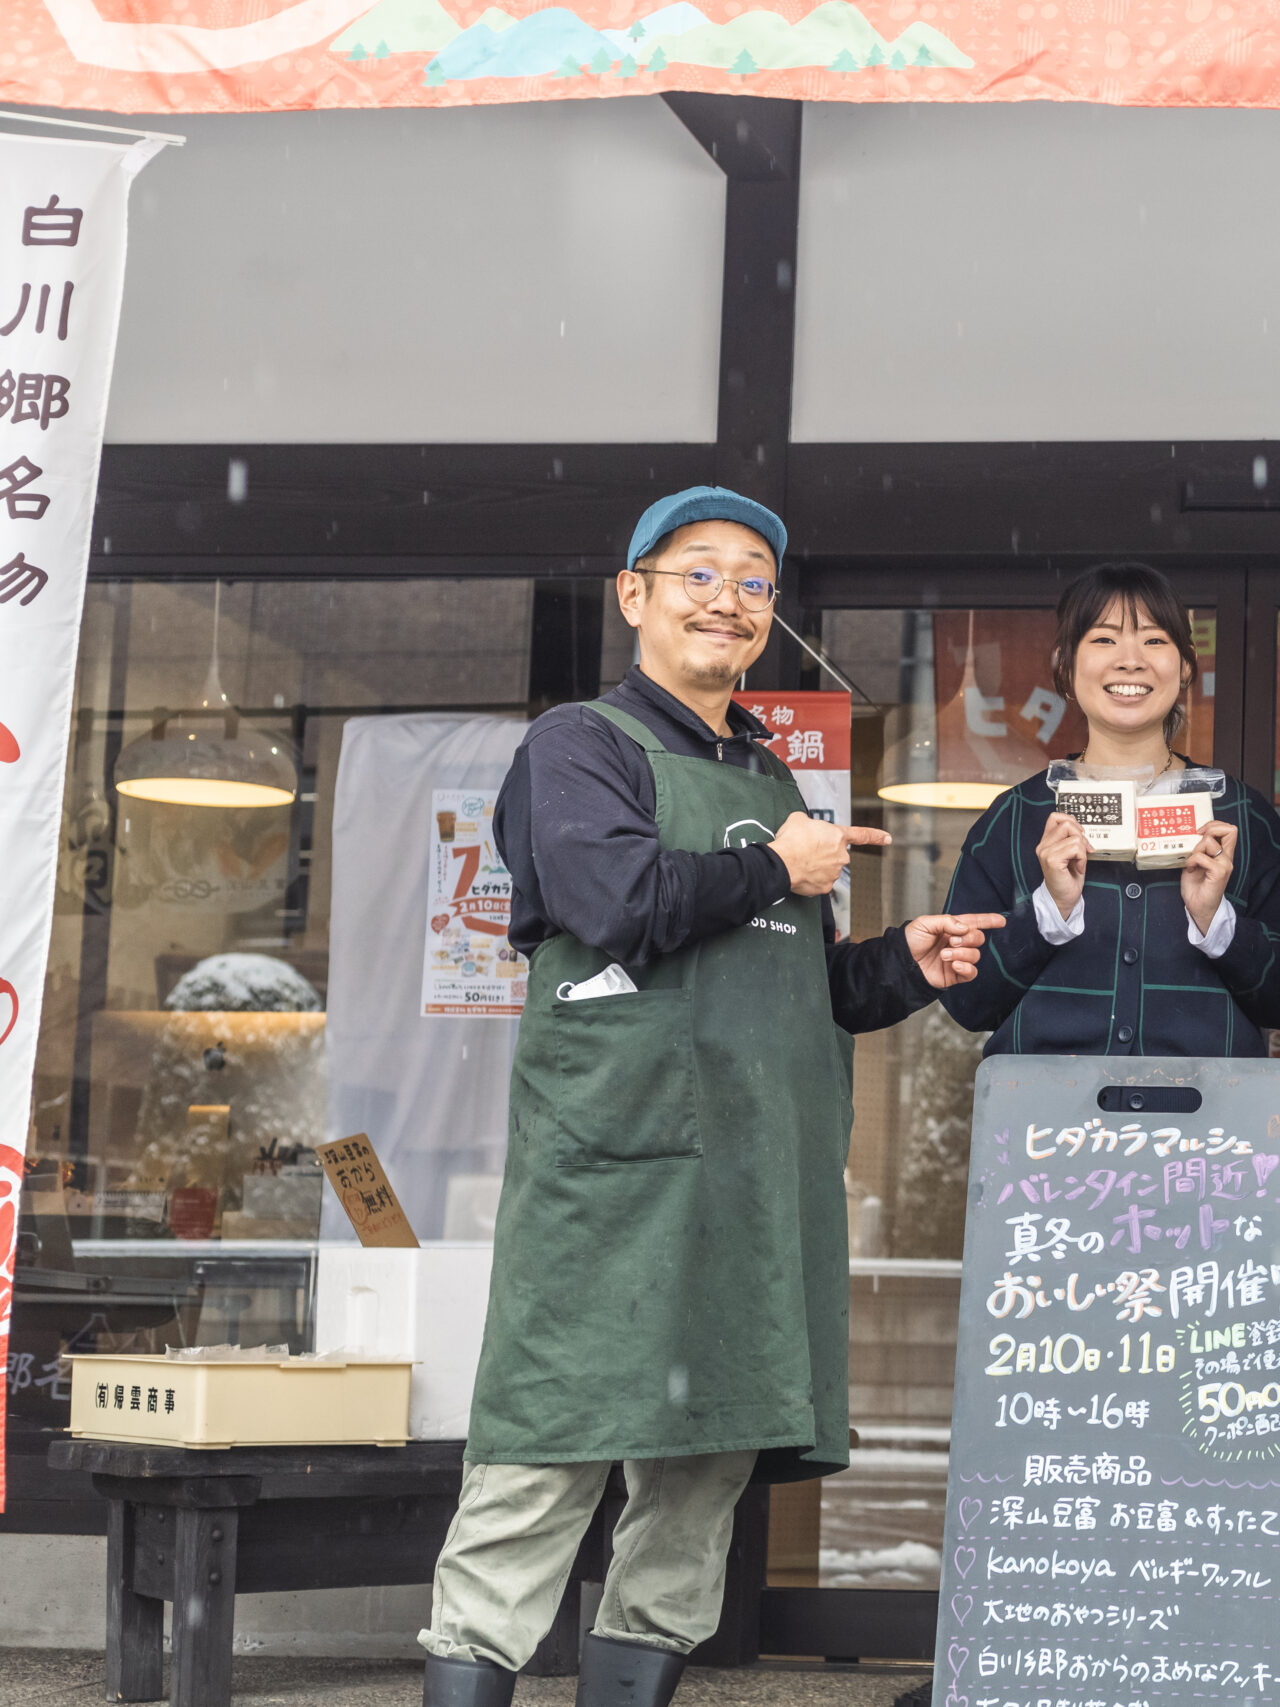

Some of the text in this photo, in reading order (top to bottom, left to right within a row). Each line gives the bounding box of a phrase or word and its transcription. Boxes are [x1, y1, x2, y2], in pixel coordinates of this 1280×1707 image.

[749, 704, 795, 726] 名物
[746, 917, 797, 936] OD SHOP
[1023, 1452, 1153, 1488] 販売商品
[1129, 1557, 1272, 1589] ベルギーワッフル
